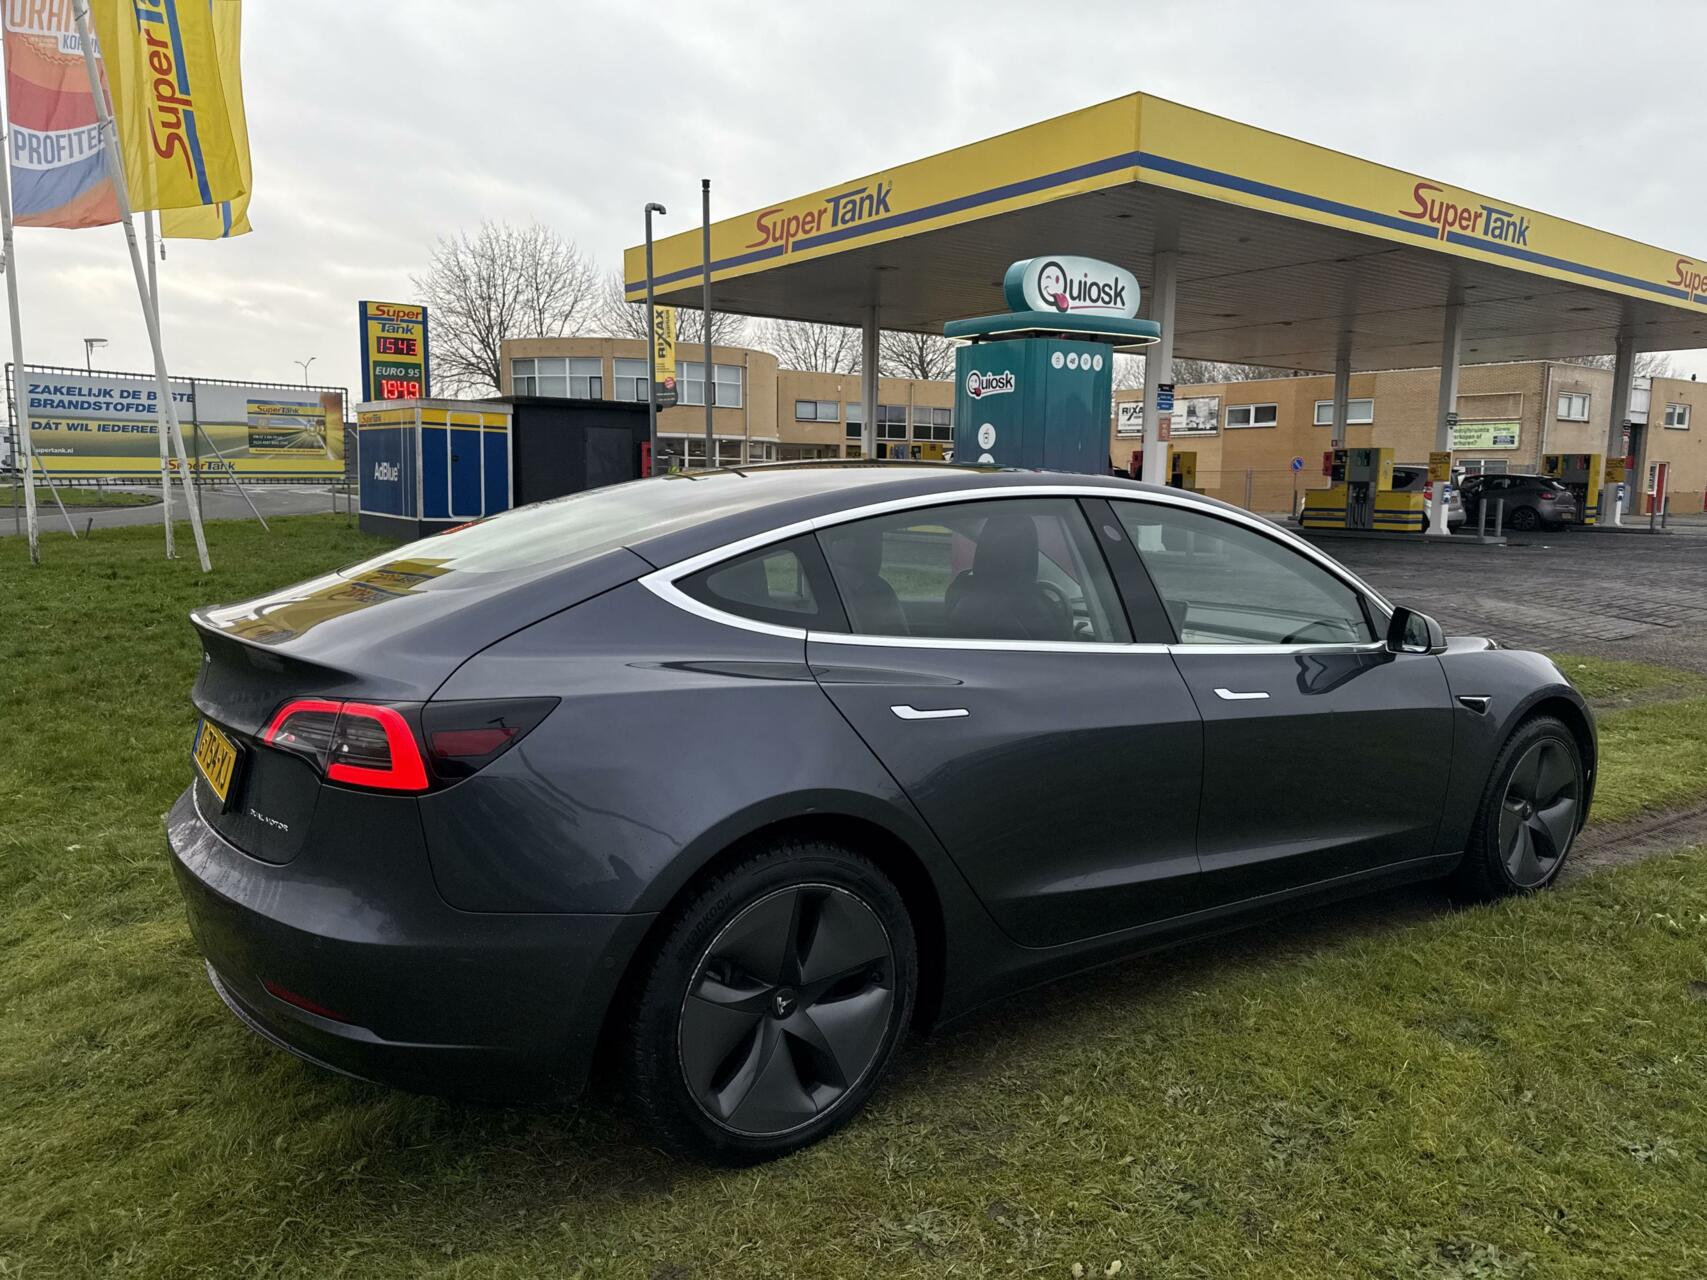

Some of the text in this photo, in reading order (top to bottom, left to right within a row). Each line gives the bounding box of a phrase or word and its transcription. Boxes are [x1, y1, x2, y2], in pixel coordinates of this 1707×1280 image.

[13, 122, 116, 165] PROFITEE
[745, 181, 892, 254] SuperTank
[1398, 182, 1530, 246] SuperTank
[1038, 261, 1125, 312] Quiosk
[1667, 259, 1707, 301] Supe
[370, 305, 422, 322] Super
[377, 321, 415, 335] Tank
[375, 366, 420, 378] EURO 95
[28, 384, 195, 403] ZAKELIJK DE BSTE
[968, 372, 1013, 396] Quiosk
[1122, 405, 1143, 421] RIXA
[31, 419, 62, 431] DÁT
[66, 422, 93, 432] WIL
[374, 462, 399, 481] AdBlue
